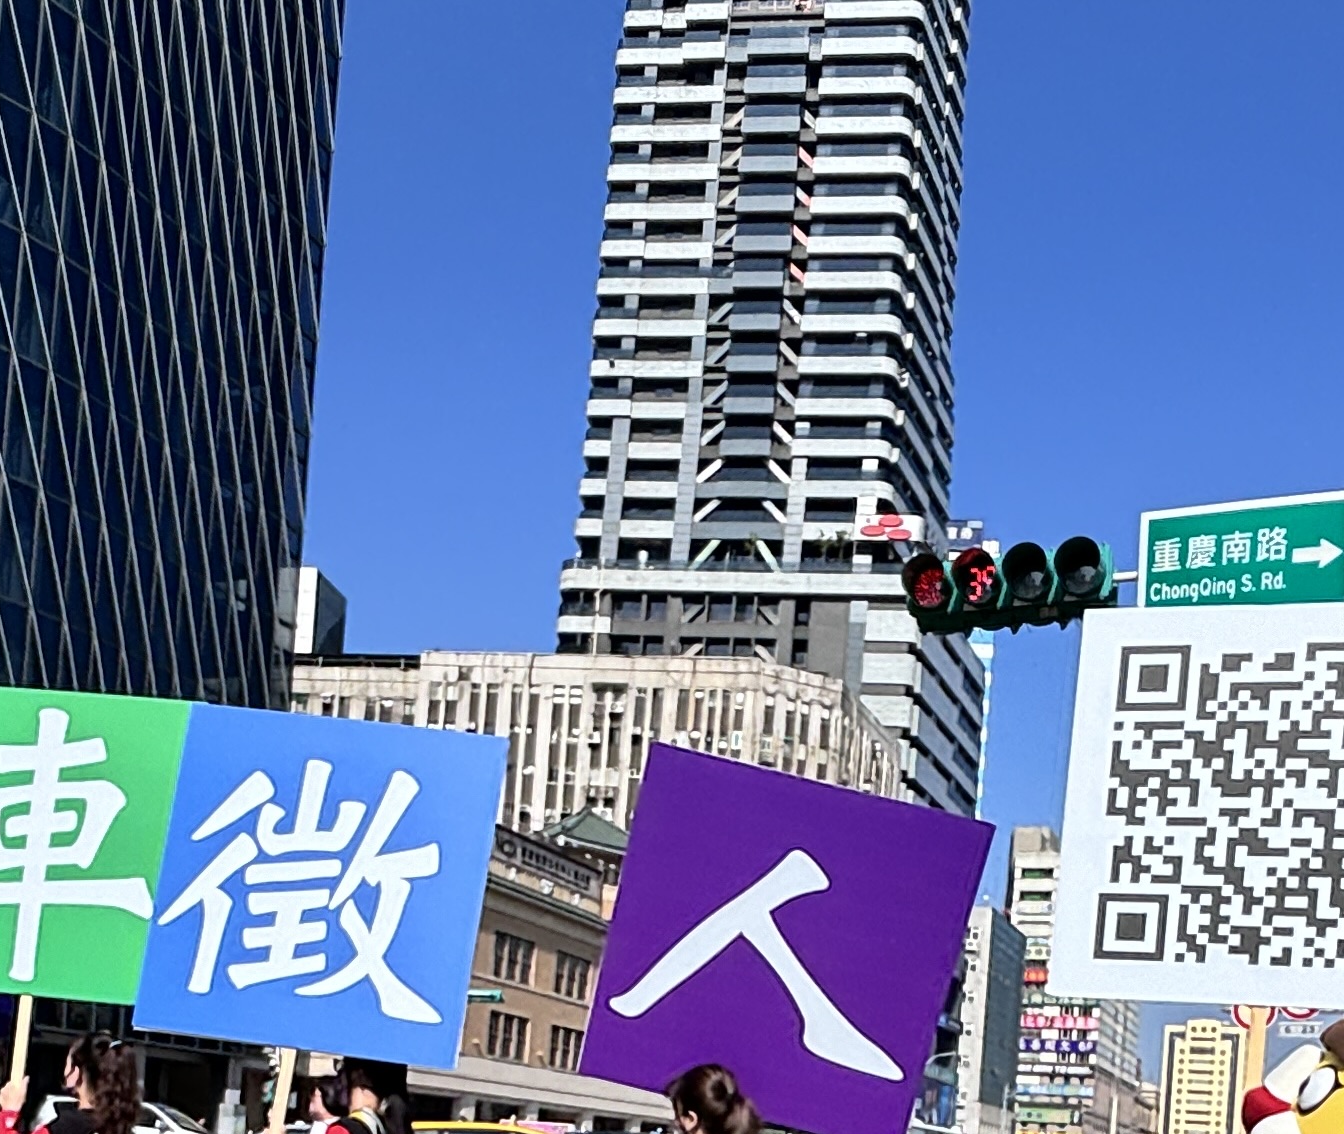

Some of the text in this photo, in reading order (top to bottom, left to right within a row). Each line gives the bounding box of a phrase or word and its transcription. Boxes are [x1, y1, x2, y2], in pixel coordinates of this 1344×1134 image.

[1150, 571, 1287, 602] ChongQing S. Rd.
[1151, 526, 1288, 573] 重慶南路
[158, 759, 442, 1023] 徵
[609, 848, 905, 1080] 人
